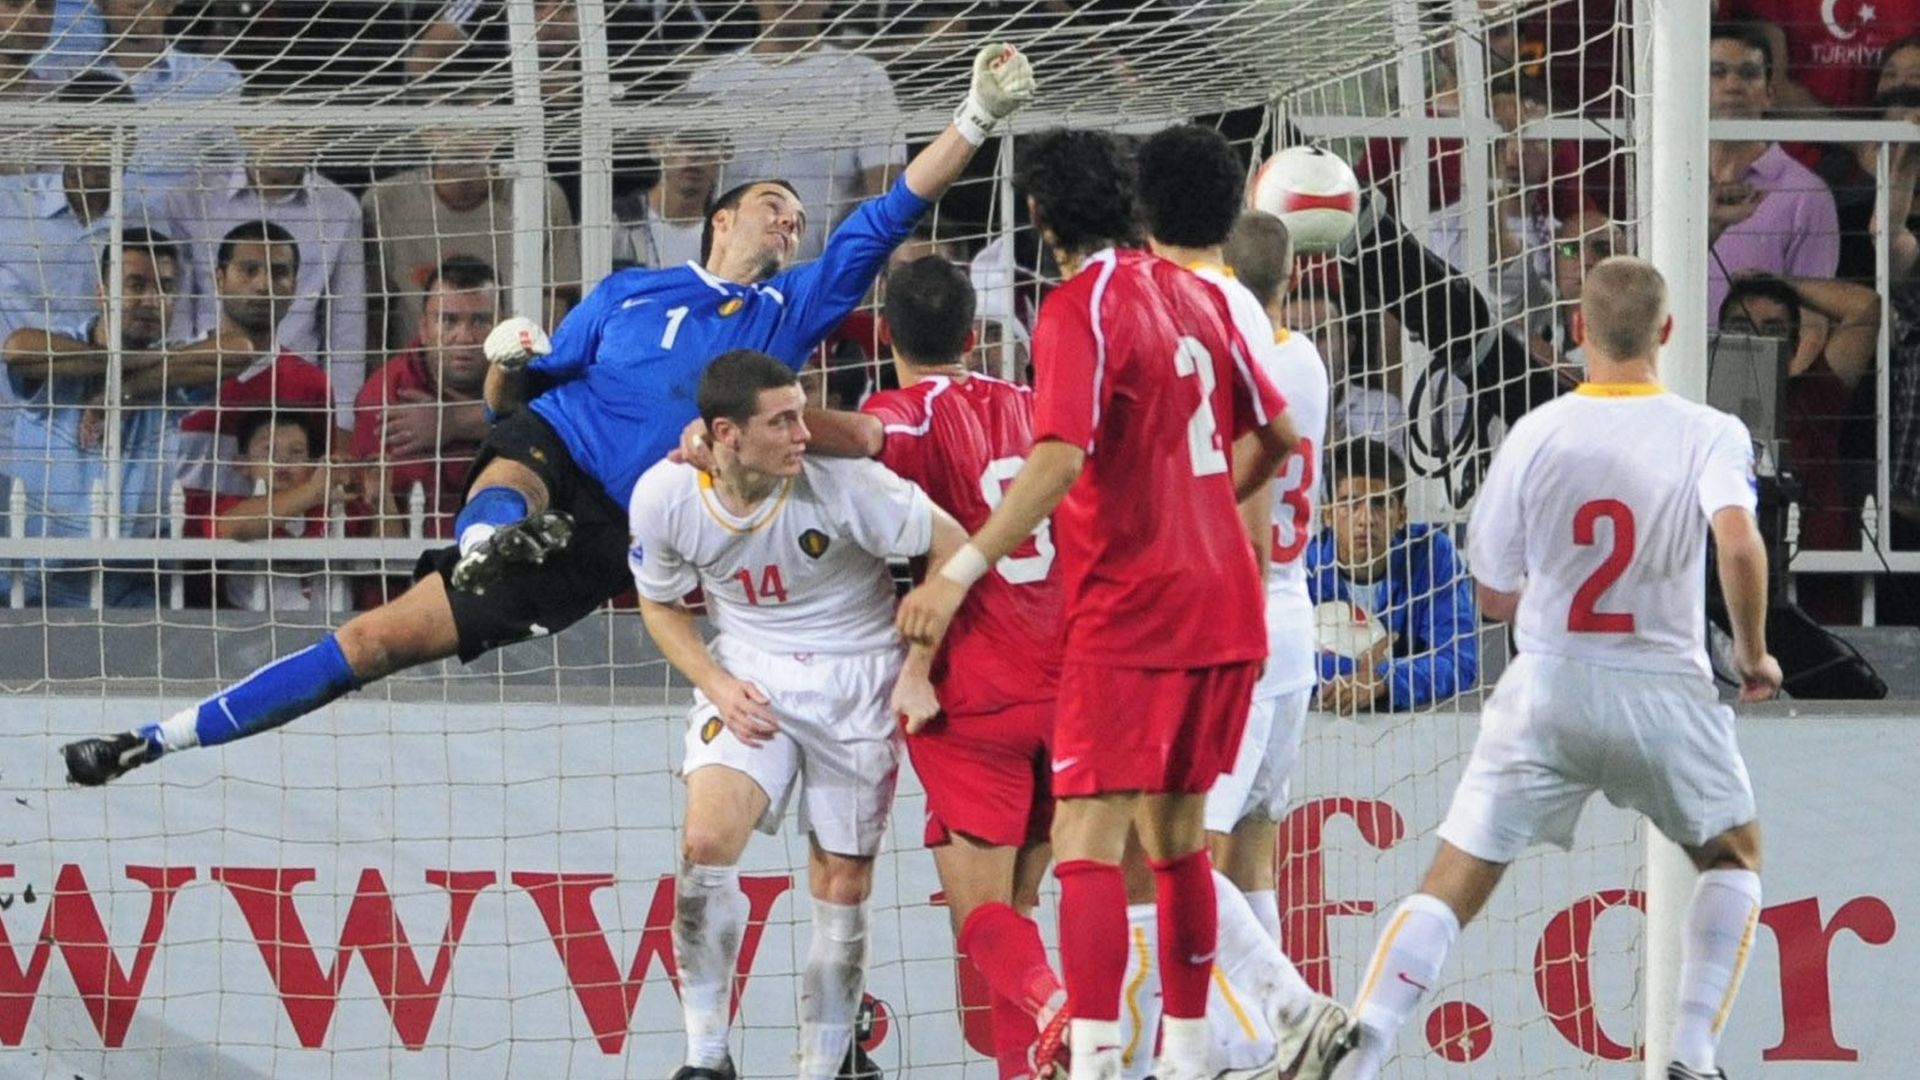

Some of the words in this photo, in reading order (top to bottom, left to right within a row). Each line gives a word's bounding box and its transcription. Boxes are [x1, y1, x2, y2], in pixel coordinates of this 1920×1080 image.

[660, 306, 689, 350] 1
[1174, 333, 1228, 477] 2
[1270, 436, 1313, 564] 3
[734, 564, 788, 607] 14
[1568, 499, 1636, 633] 2
